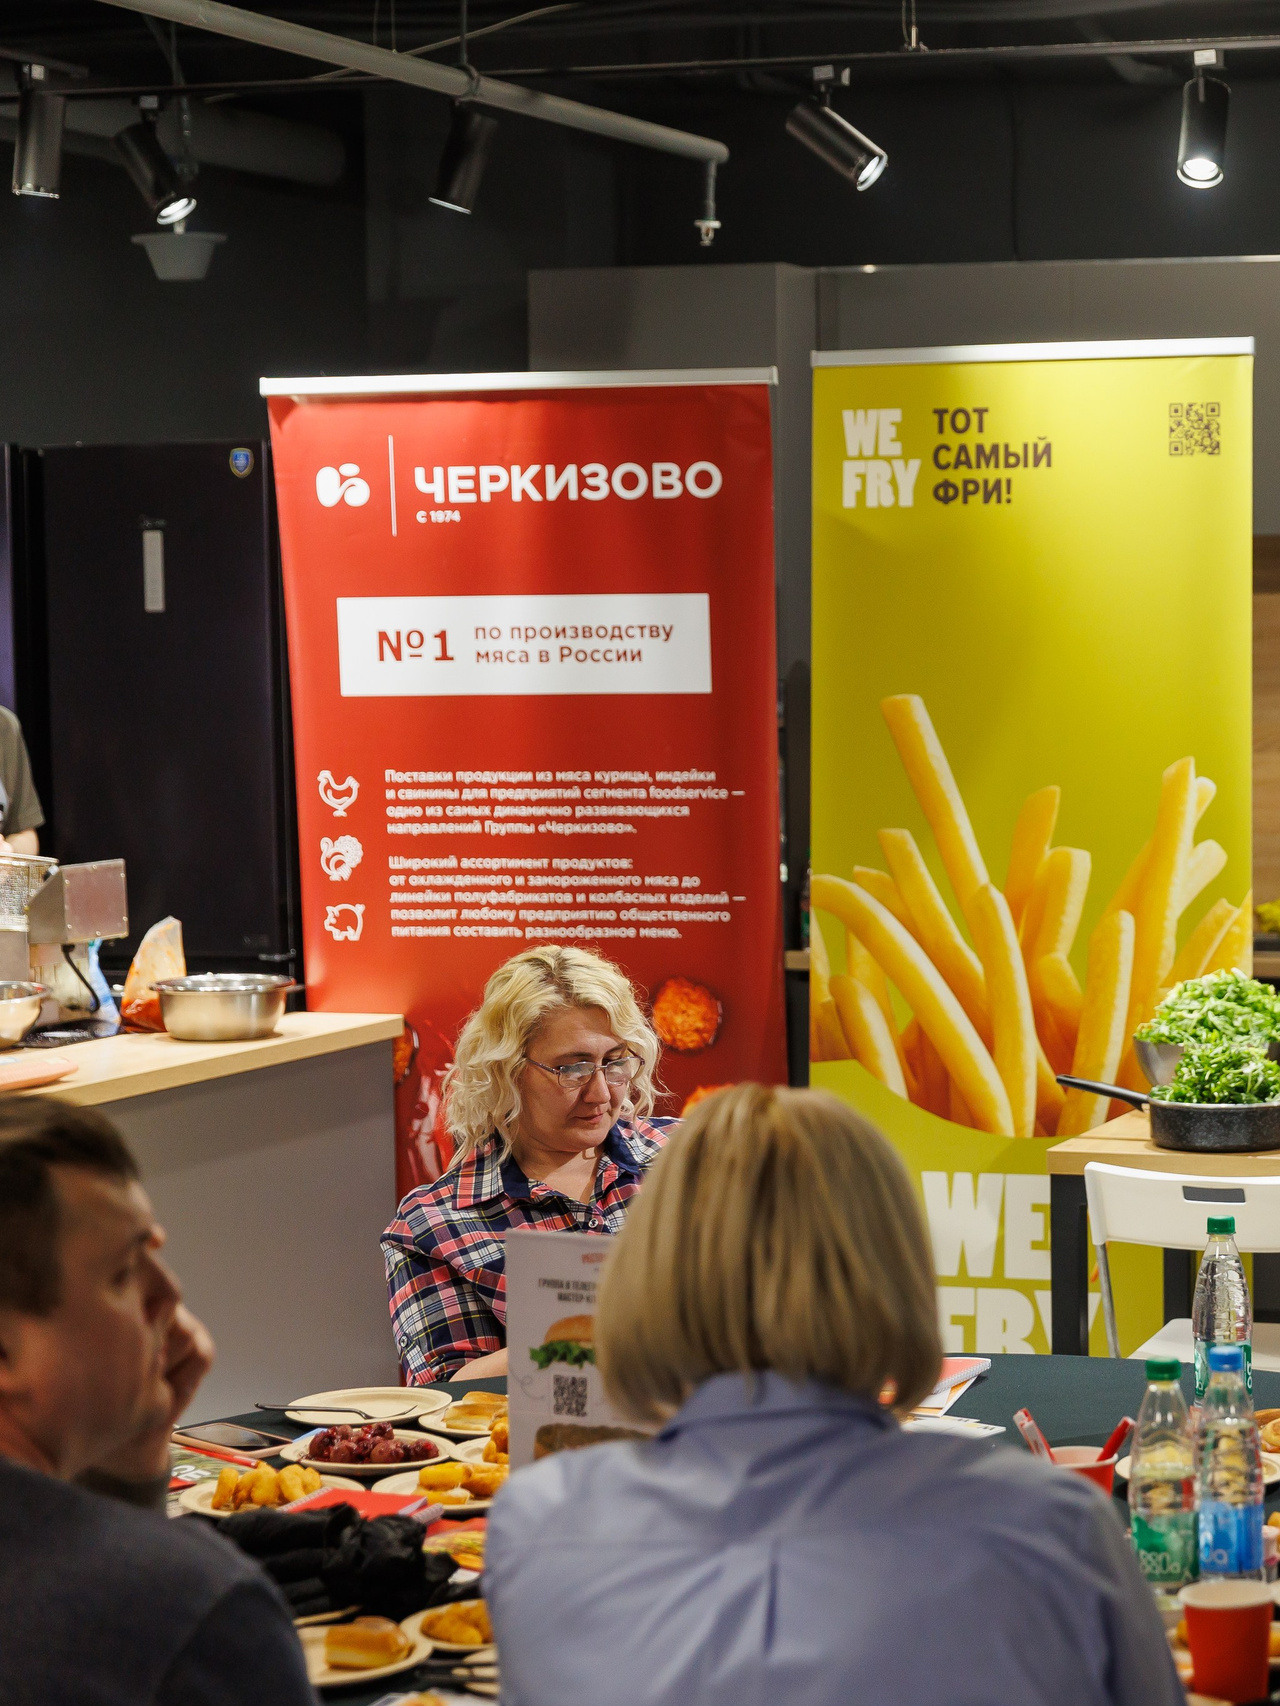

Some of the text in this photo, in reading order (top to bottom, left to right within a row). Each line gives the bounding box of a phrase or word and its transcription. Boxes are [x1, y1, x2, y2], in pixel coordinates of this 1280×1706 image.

[932, 407, 989, 434] ТОТ
[842, 408, 902, 457] WE
[932, 436, 1053, 470] САМЫЙ
[414, 460, 723, 504] ЧЕРКИЗОВО
[842, 458, 921, 508] FRY
[932, 478, 1013, 506] ФРИ!
[416, 510, 461, 523] С 1974
[474, 623, 674, 643] по производству
[475, 646, 642, 664] мяса в России
[385, 769, 716, 784] Поставки продукции из мяса курицы, индейки
[385, 789, 396, 800] и
[398, 789, 459, 800] свинины
[461, 788, 488, 801] для
[490, 786, 581, 801] предприятий
[583, 788, 647, 799] сегмента
[649, 785, 729, 800] foodservice
[386, 805, 690, 819] одно из самых динамично развивающихся
[387, 820, 482, 836] направлений
[485, 820, 535, 836] Группы
[388, 855, 633, 871] Широкий ассортимент продуктов:
[389, 875, 700, 888] от охлажденного и замороженного мяса до
[390, 889, 451, 903] линейки
[454, 890, 573, 905] полуфабрикатов
[576, 893, 586, 903] и
[589, 890, 667, 904] колбасных
[670, 891, 729, 905] изделий
[391, 907, 731, 922] позволит любому предприятию общественного
[391, 925, 682, 940] питания составить разнообразное меню.
[921, 1170, 1051, 1280] WE
